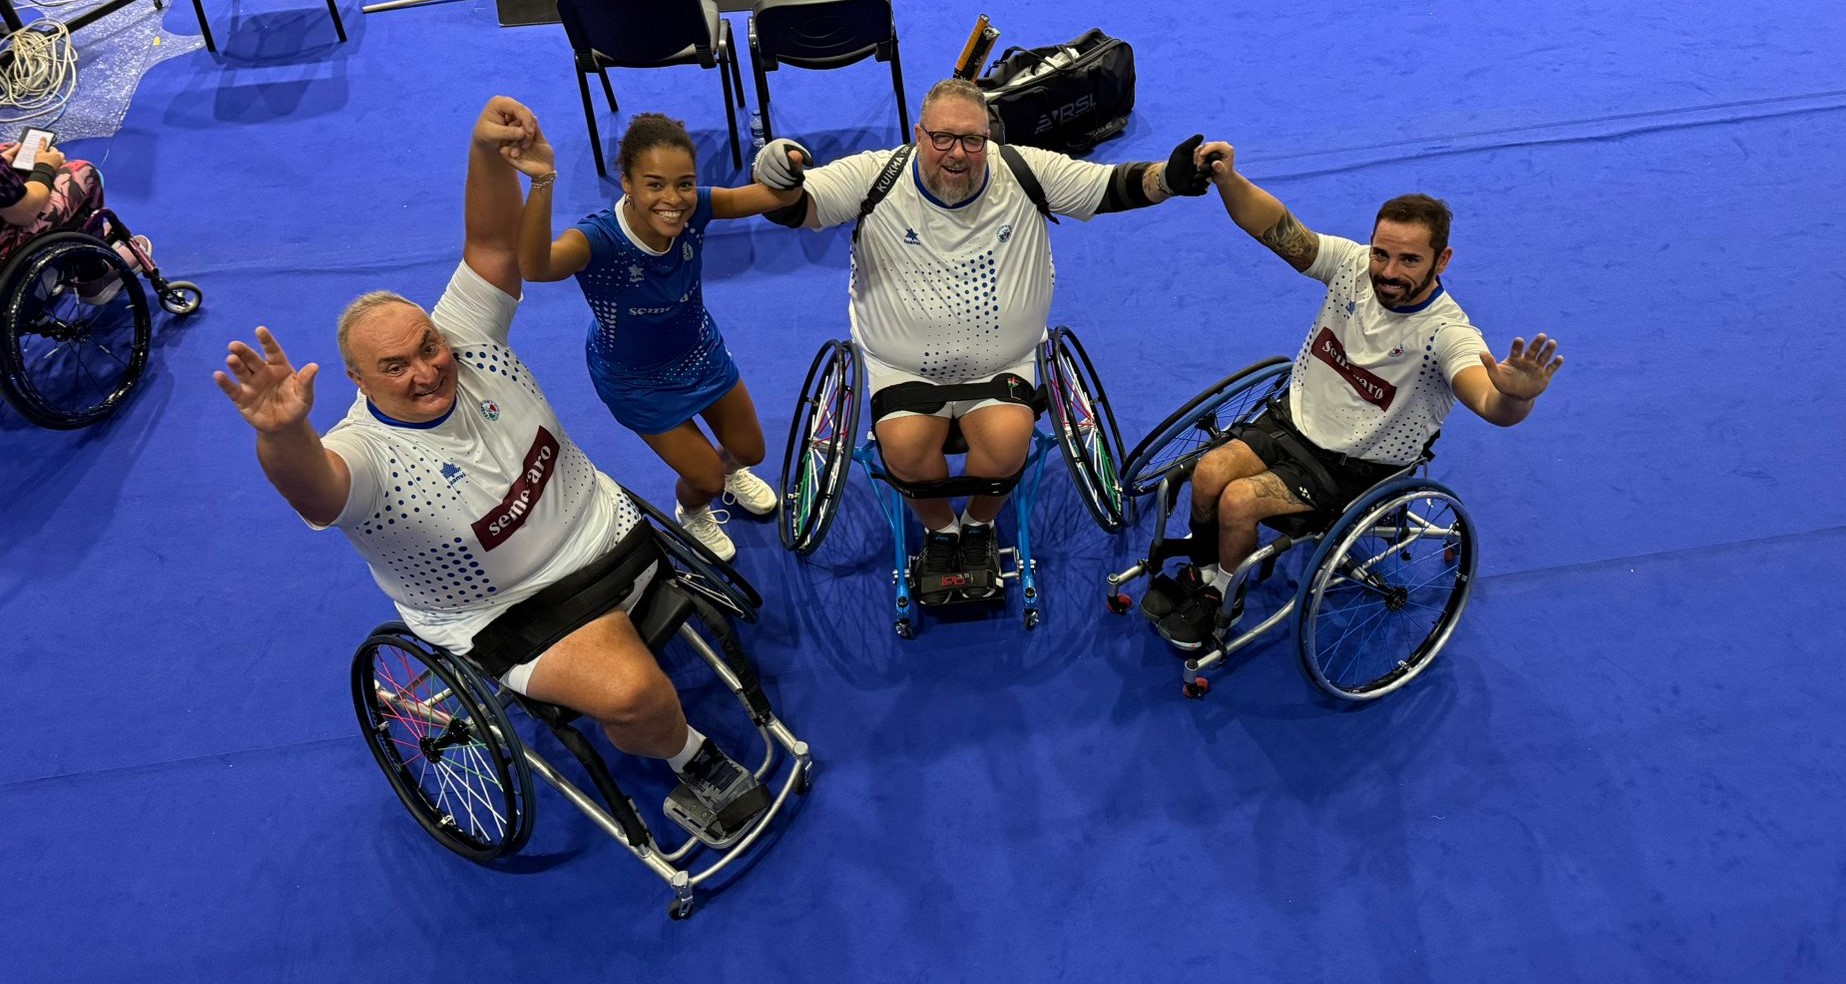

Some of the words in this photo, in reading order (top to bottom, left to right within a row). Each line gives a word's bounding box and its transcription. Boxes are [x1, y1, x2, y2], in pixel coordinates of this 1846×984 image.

[1059, 92, 1096, 121] RSL
[876, 156, 905, 193] KUIKMA
[489, 445, 551, 536] semearo
